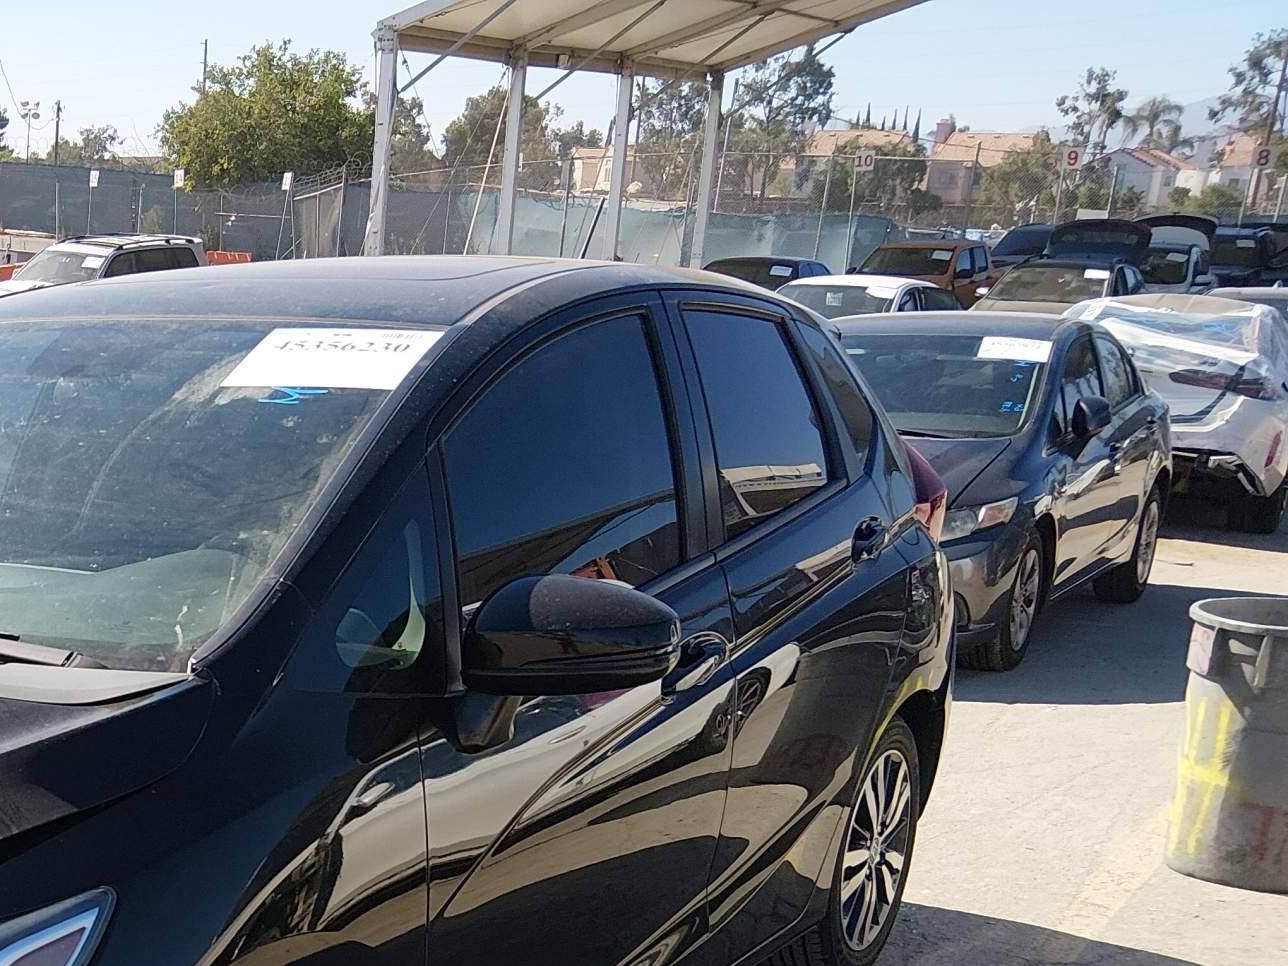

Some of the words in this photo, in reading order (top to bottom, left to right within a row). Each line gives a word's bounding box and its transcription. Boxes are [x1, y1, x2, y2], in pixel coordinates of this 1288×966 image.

[856, 154, 873, 167] 10
[1067, 150, 1079, 166] 9
[1256, 148, 1271, 166] 8
[273, 340, 411, 352] 45356230
